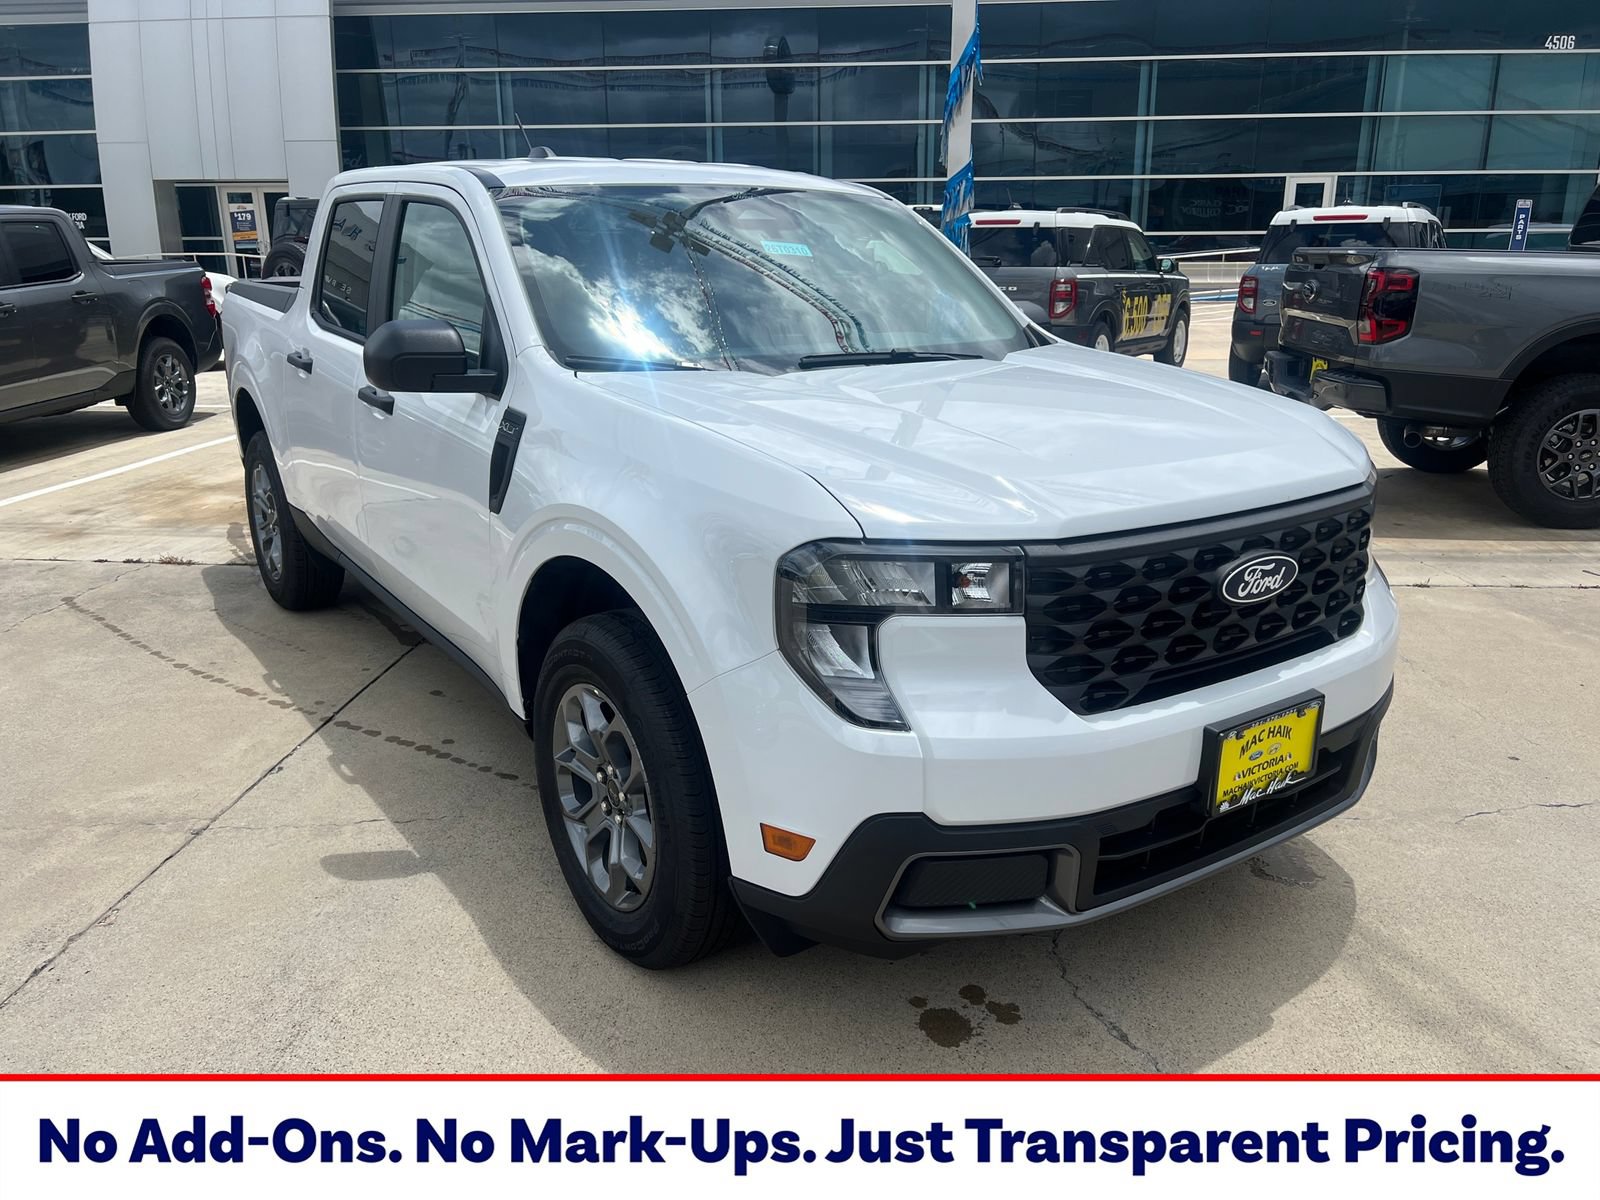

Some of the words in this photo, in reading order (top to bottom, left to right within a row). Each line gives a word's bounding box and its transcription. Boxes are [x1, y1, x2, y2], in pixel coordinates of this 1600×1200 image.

[1544, 35, 1576, 50] 4506
[72, 212, 88, 221] FORD
[233, 212, 252, 221] $179
[1515, 213, 1526, 240] PARTS
[1237, 562, 1286, 598] Ford
[1238, 728, 1266, 760] MAC
[1266, 724, 1293, 741] HAIK
[1240, 754, 1284, 779] VICTORIA
[1221, 761, 1299, 798] MACHAIKVICTORIA.COM
[1239, 787, 1265, 806] Mac
